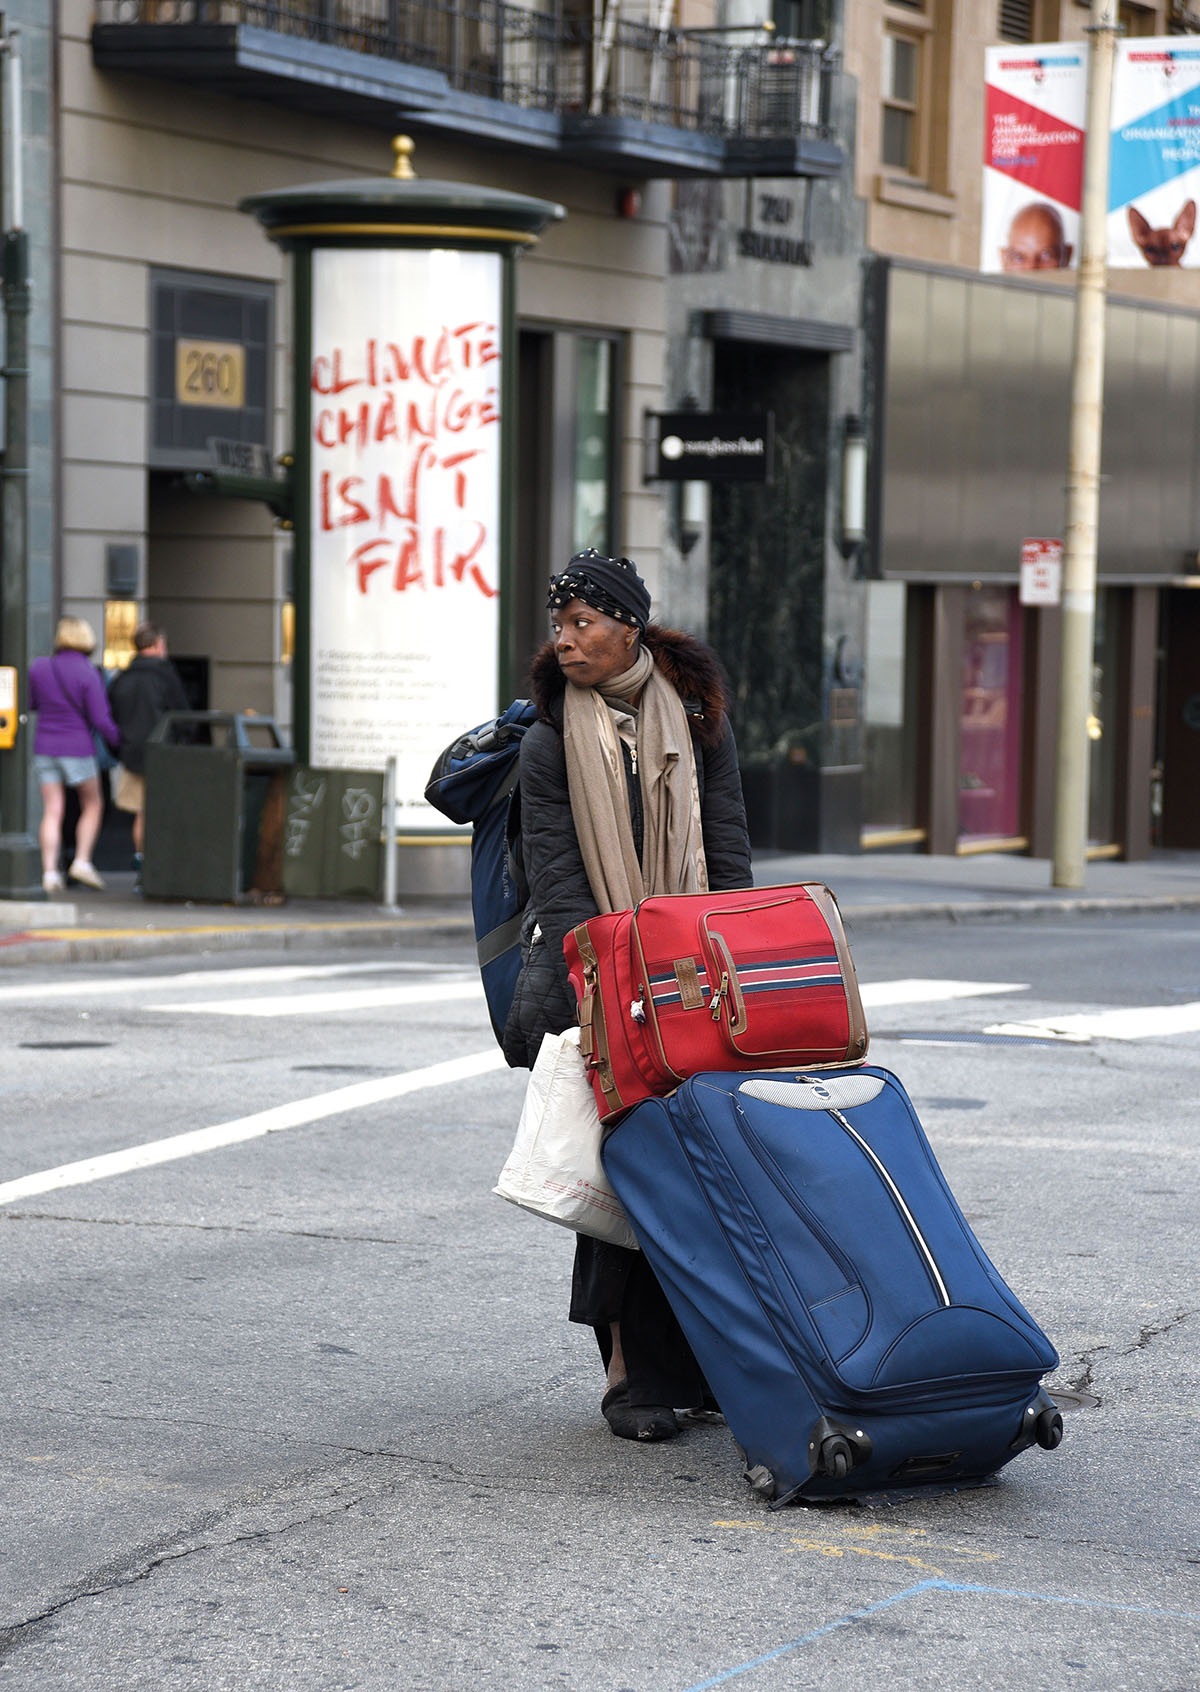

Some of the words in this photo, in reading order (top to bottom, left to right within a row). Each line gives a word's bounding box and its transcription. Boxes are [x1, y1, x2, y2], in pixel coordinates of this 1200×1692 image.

[993, 113, 1017, 124] THE
[185, 350, 236, 395] 260
[311, 321, 500, 395] CLIMATE
[315, 388, 500, 450] CHANGE
[321, 442, 485, 530] ISN'T
[348, 520, 500, 597] FAIR
